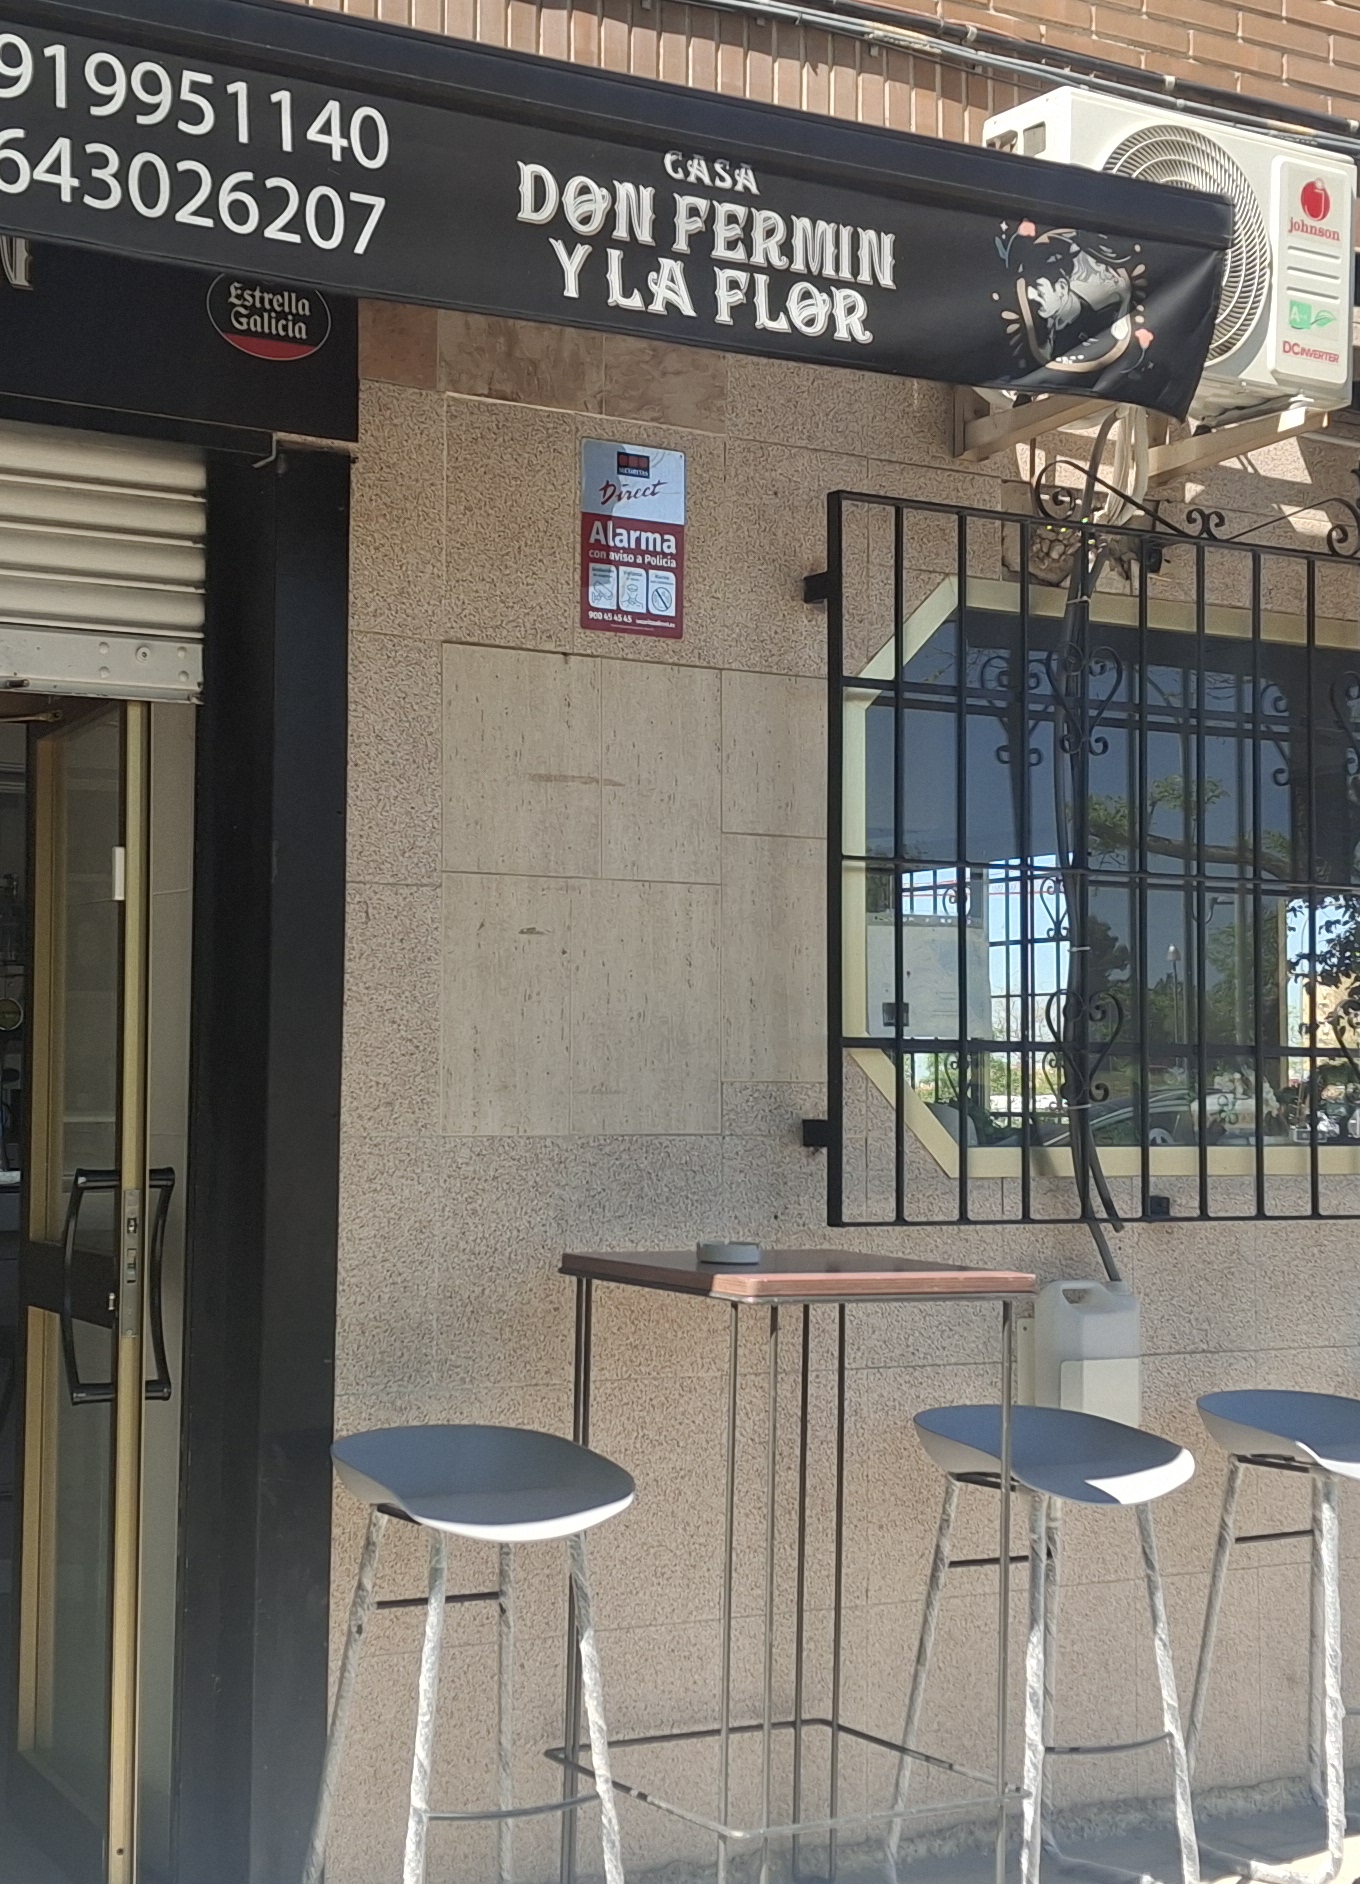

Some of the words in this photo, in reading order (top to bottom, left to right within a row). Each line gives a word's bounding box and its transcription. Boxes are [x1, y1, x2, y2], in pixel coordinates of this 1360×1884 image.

[662, 150, 760, 195] CASA
[516, 160, 656, 247] DON
[672, 192, 897, 289] FERMIN
[1288, 217, 1341, 241] johnson
[228, 281, 311, 316] Estrella
[548, 237, 593, 299] Y
[605, 247, 697, 318] LA
[713, 266, 874, 344] FLOR
[230, 306, 308, 340] Galicia
[598, 479, 669, 507] Direct
[588, 520, 677, 555] Alarma
[588, 550, 607, 560] con
[608, 551, 635, 564] aviso
[636, 554, 643, 564] a
[588, 610, 603, 621] 900
